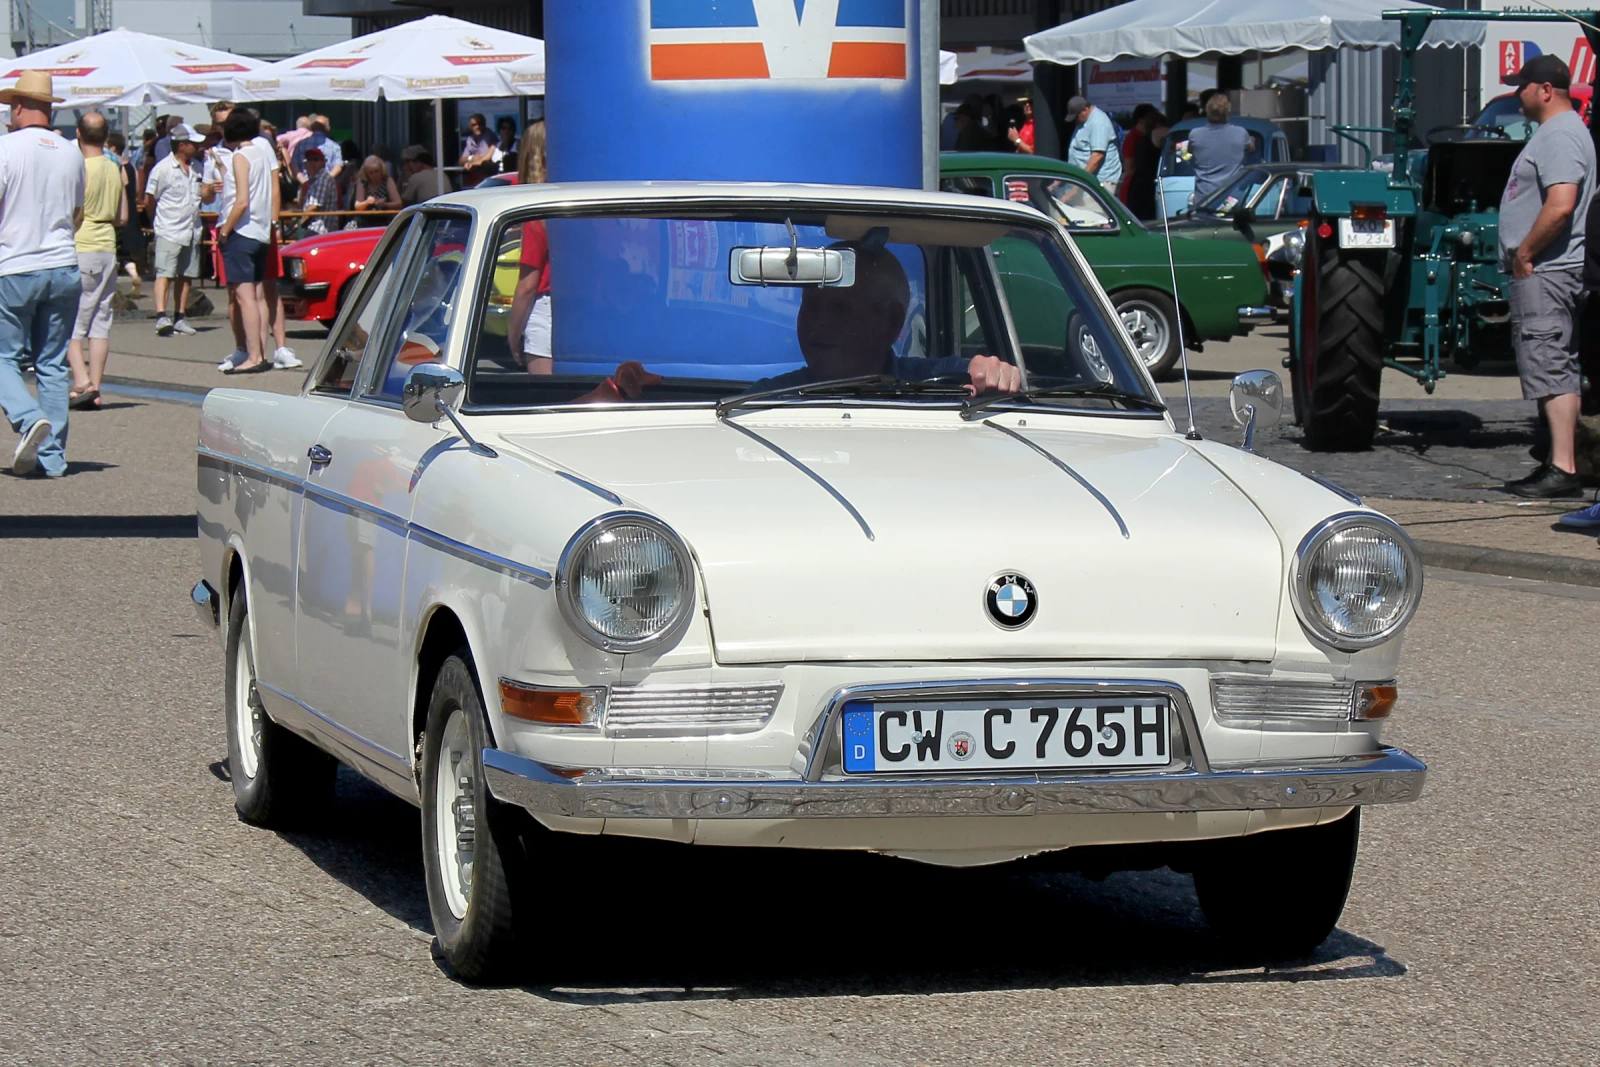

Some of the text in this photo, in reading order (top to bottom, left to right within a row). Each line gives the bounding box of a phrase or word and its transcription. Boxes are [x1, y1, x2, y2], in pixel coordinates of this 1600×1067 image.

[990, 575, 1034, 594] BMW
[854, 744, 866, 760] D
[878, 709, 944, 763] CW
